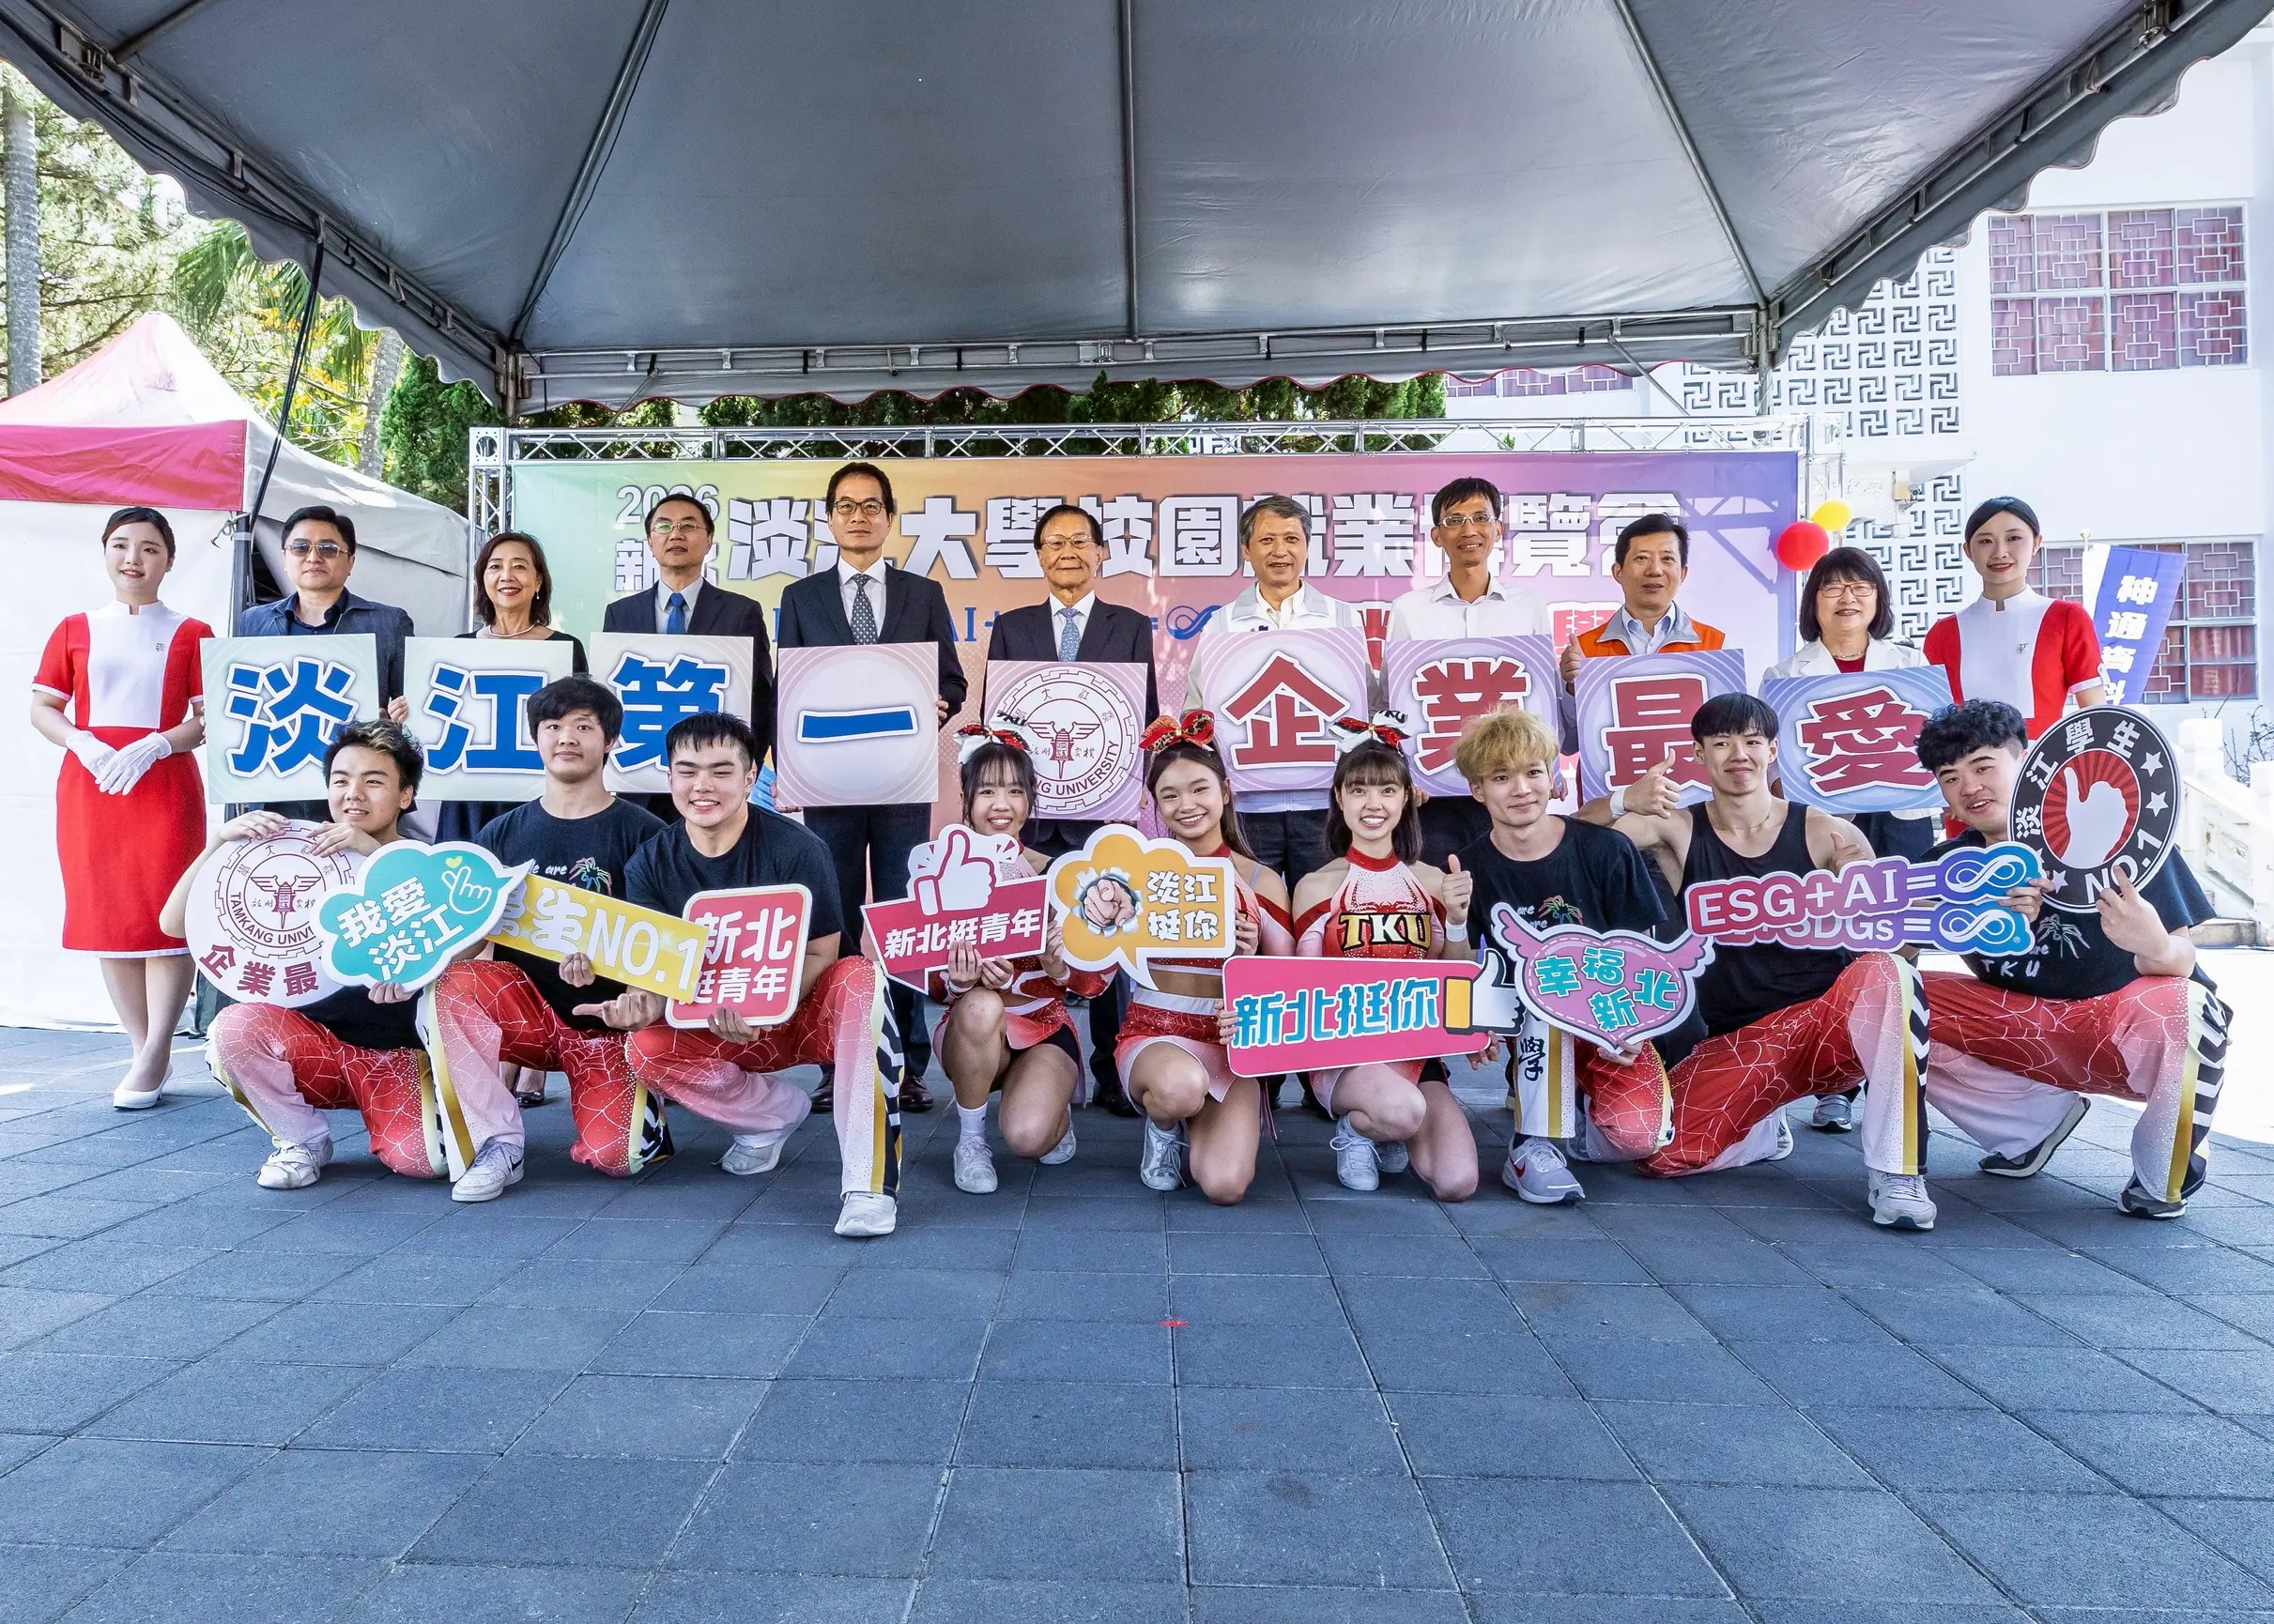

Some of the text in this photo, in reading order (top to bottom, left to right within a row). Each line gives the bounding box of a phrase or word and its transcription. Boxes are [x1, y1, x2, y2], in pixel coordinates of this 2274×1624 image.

[226, 657, 357, 777] 淡
[425, 663, 548, 774] 江
[610, 654, 730, 774] 第
[798, 708, 916, 743] 一
[1225, 653, 1350, 771] 企
[1415, 658, 1530, 773] 業
[1600, 674, 1713, 790] 最
[1795, 686, 1934, 796] 愛
[1055, 740, 1119, 796] UNIVERSITY
[2015, 716, 2141, 839] 淡江學生
[1146, 870, 1218, 904] 淡江
[2084, 828, 2163, 905] NO.1
[230, 891, 274, 944] TAMKANG
[336, 875, 433, 949] 我愛
[367, 902, 466, 982] 淡江
[695, 907, 797, 966] 新北
[883, 908, 1041, 959] 新北挺青年
[1147, 908, 1219, 942] 挺你
[1339, 912, 1432, 952] TKU
[1534, 944, 1625, 998] 幸福
[1587, 967, 1679, 1033] 新北
[1231, 976, 1440, 1049] 新北挺你
[1517, 1035, 1545, 1082] 學
